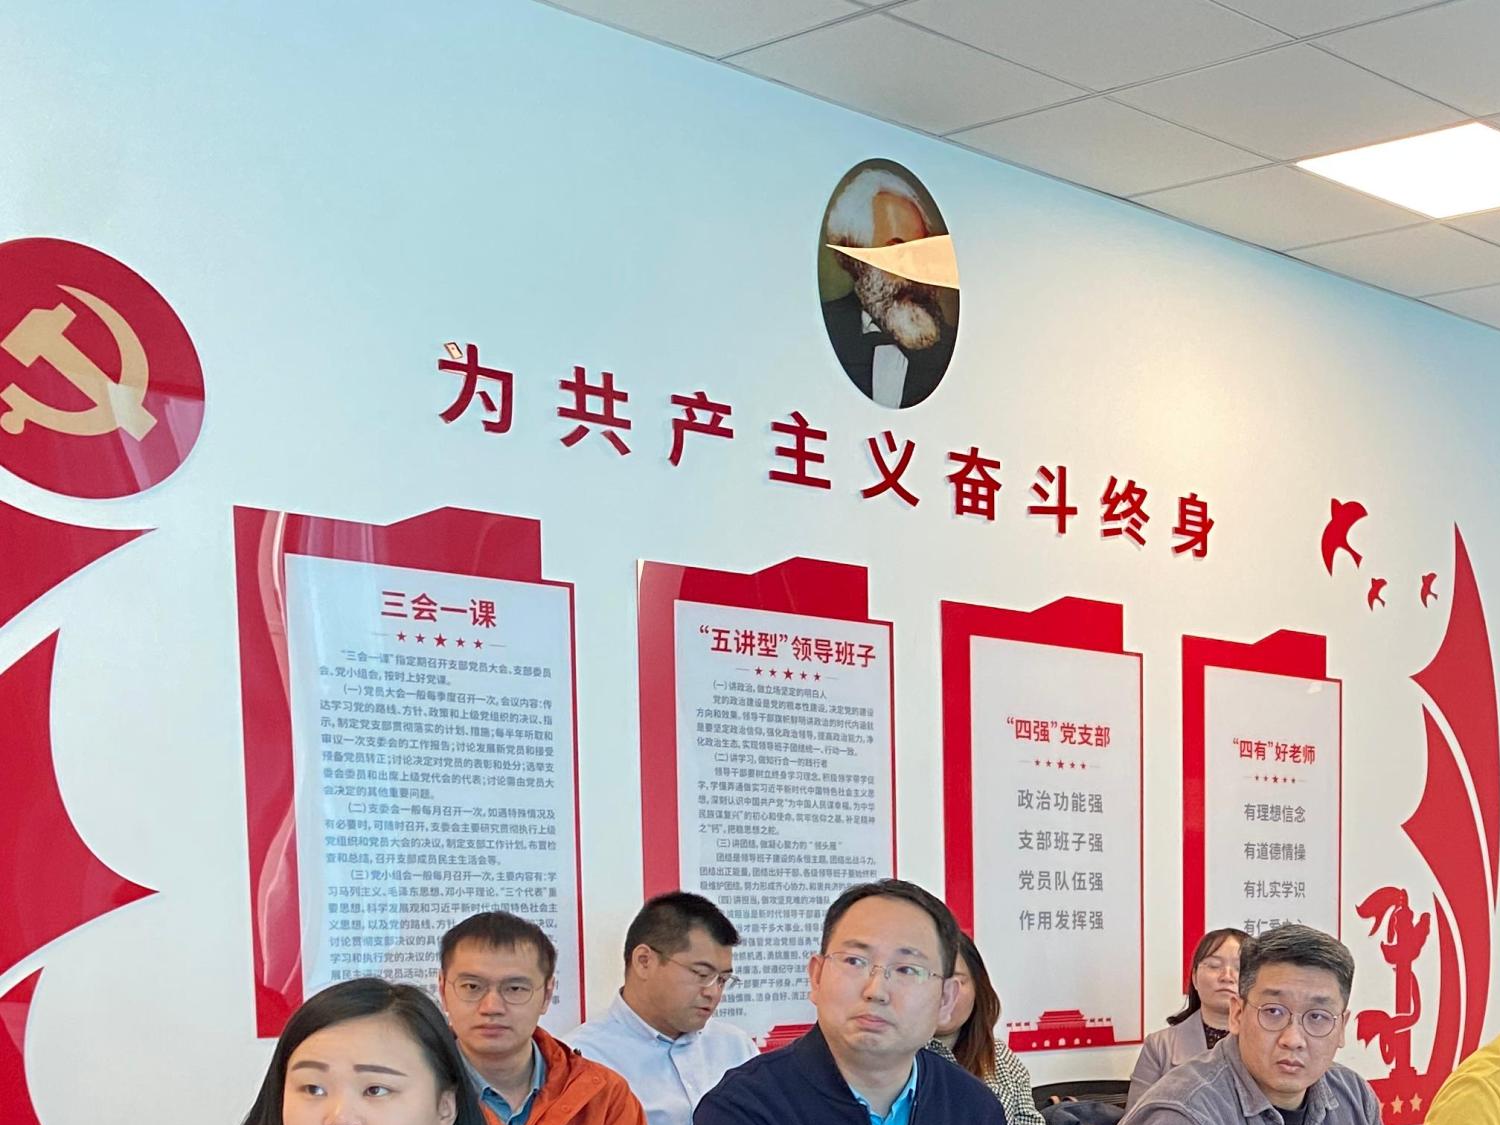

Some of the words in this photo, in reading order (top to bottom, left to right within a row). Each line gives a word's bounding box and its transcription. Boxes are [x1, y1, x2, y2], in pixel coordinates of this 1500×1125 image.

[438, 342, 1214, 558] 为共产主义奋斗终身
[381, 590, 497, 628] 三会一课
[699, 624, 876, 668] “五讲型”领导班子
[1007, 716, 1110, 747] “四强”党支部
[1233, 738, 1315, 764] “四有”好老师
[1018, 789, 1103, 813] 政治功能强
[1244, 803, 1306, 823] 有理想信念
[1018, 829, 1103, 852] 支部班子强
[1244, 841, 1306, 861] 有道德情操
[1018, 870, 1103, 891] 党员队伍强
[1244, 880, 1306, 898] 有扎实学识
[1019, 909, 1104, 931] 作用发挥强
[1244, 918, 1302, 937] 有仁爱
